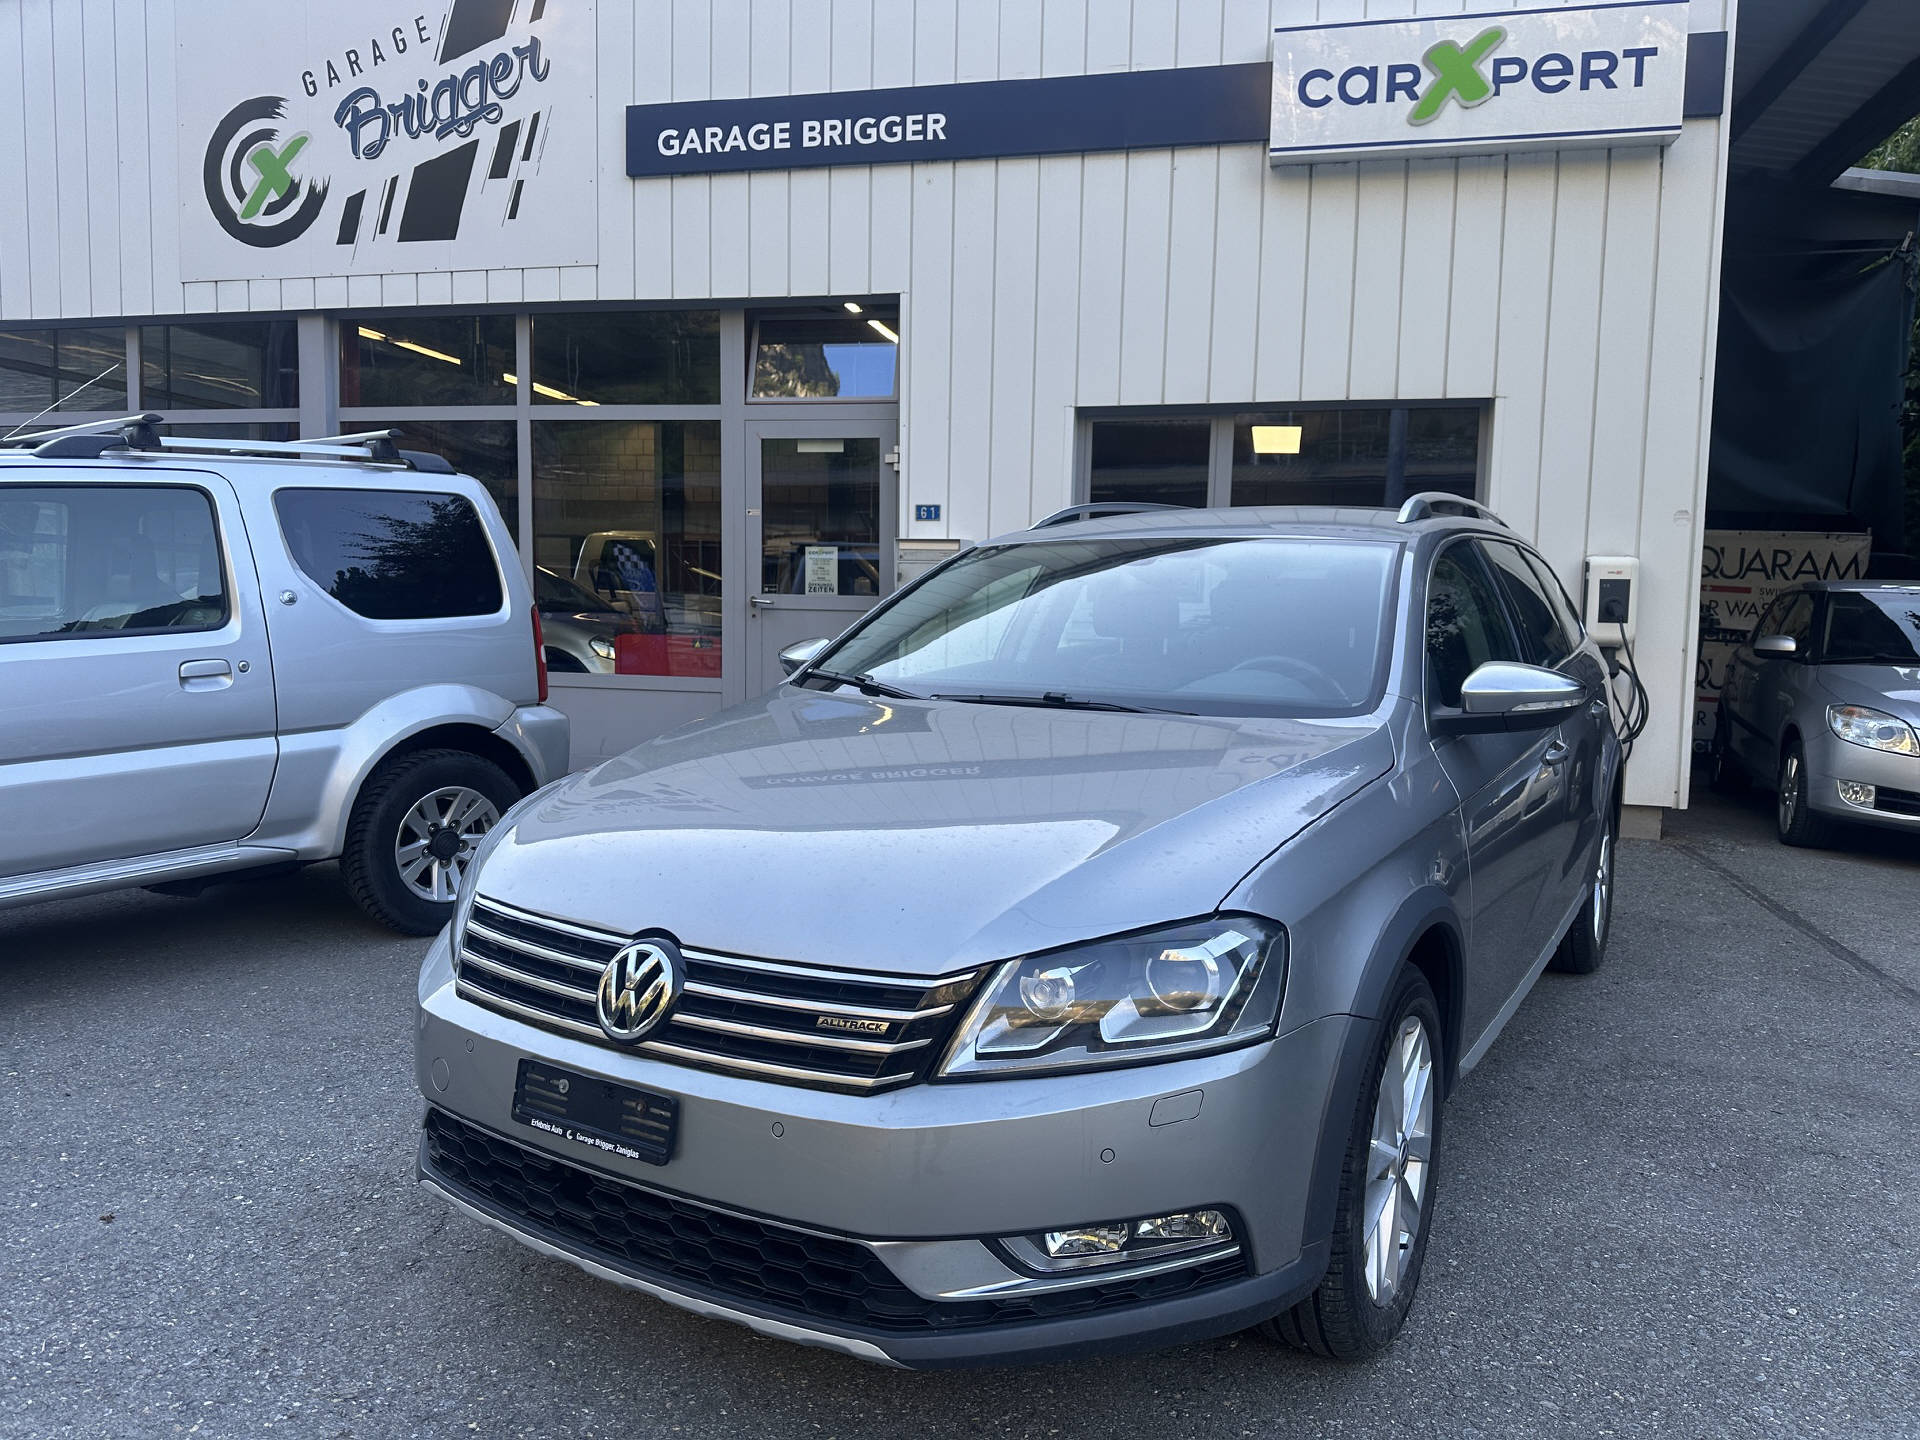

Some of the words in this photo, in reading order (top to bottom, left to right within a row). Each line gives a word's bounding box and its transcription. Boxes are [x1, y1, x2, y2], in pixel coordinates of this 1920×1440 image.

[302, 15, 431, 98] GARAGE
[334, 35, 551, 160] Brigger
[657, 121, 791, 157] GARAGE
[802, 112, 947, 149] BRIGGER
[920, 506, 935, 519] 61
[820, 1018, 884, 1032] ALLTRACK
[530, 1118, 551, 1131] Erlebnis
[551, 1124, 563, 1136] Auto
[576, 1132, 595, 1145] Garage
[616, 1144, 640, 1159] Zaniglas
